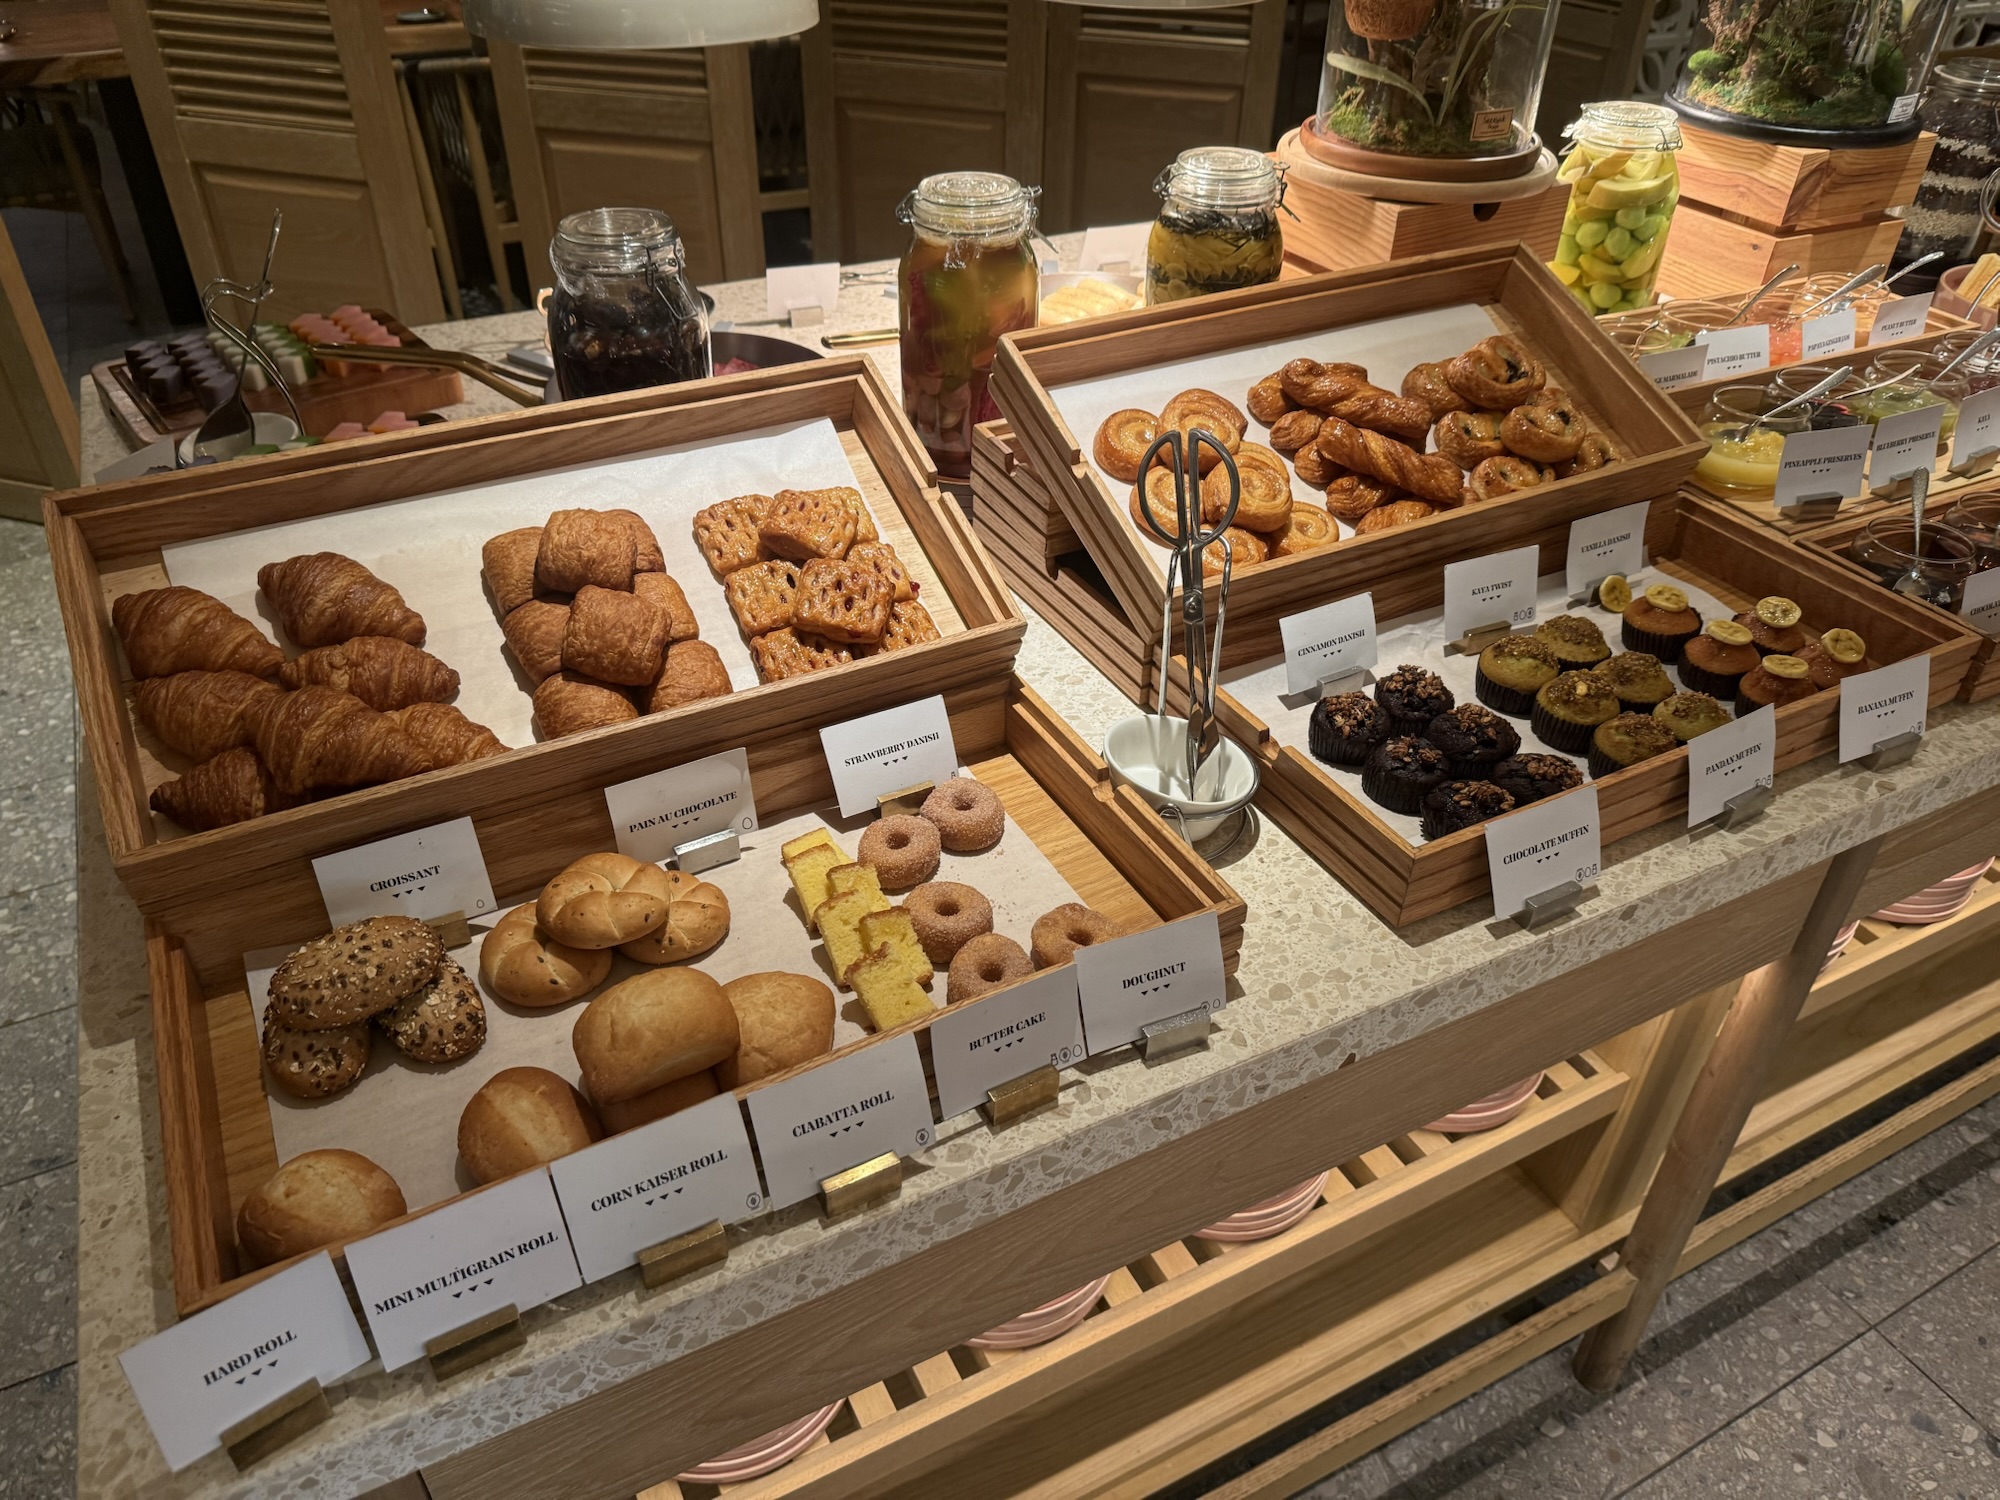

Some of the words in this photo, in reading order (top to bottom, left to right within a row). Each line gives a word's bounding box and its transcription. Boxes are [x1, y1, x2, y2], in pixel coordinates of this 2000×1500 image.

[1706, 354, 1739, 366] PISTACHIO
[1738, 351, 1762, 362] BUTTER
[1876, 437, 1909, 452] BLUEBERRY
[1908, 431, 1937, 445] PRESERVE
[1783, 457, 1823, 469] PINEAPPLE
[1822, 452, 1864, 464] PRESERVES
[1580, 538, 1608, 554] VANILLA
[1606, 532, 1632, 547] DANISH
[1471, 585, 1491, 597] KAYA
[1490, 580, 1514, 592] TWIST
[1297, 637, 1339, 657] CINNAMON
[1337, 628, 1366, 645] DANISH
[1858, 698, 1888, 715] BANANA
[1887, 690, 1915, 706] MUFFIN
[844, 740, 907, 767] STRAWBERRY
[906, 731, 941, 750] DANISH
[1705, 754, 1735, 776] PANDAN
[1734, 742, 1762, 762] MUFFIN
[629, 816, 657, 833] PAIN
[656, 812, 674, 825] AU
[673, 791, 738, 819] CHOCOLATE
[1503, 837, 1558, 865] CHOCOLATE
[1557, 824, 1590, 846] MUFFIN
[369, 864, 441, 893] CROISSANT
[1122, 961, 1187, 990] DOUGHNUT
[968, 1024, 1015, 1052] BUTTER
[1015, 1011, 1047, 1032] CAKE
[792, 1104, 860, 1138] CIABATTA
[859, 1090, 896, 1112] ROLL
[591, 1186, 633, 1213] CORN
[633, 1164, 689, 1196] KAISER
[688, 1149, 729, 1174] ROLL
[374, 1288, 415, 1316] MINI
[414, 1247, 516, 1299] MULTIGRAIN
[516, 1231, 559, 1256] ROLL
[203, 1352, 252, 1387] HARD
[252, 1329, 298, 1360] ROLL
